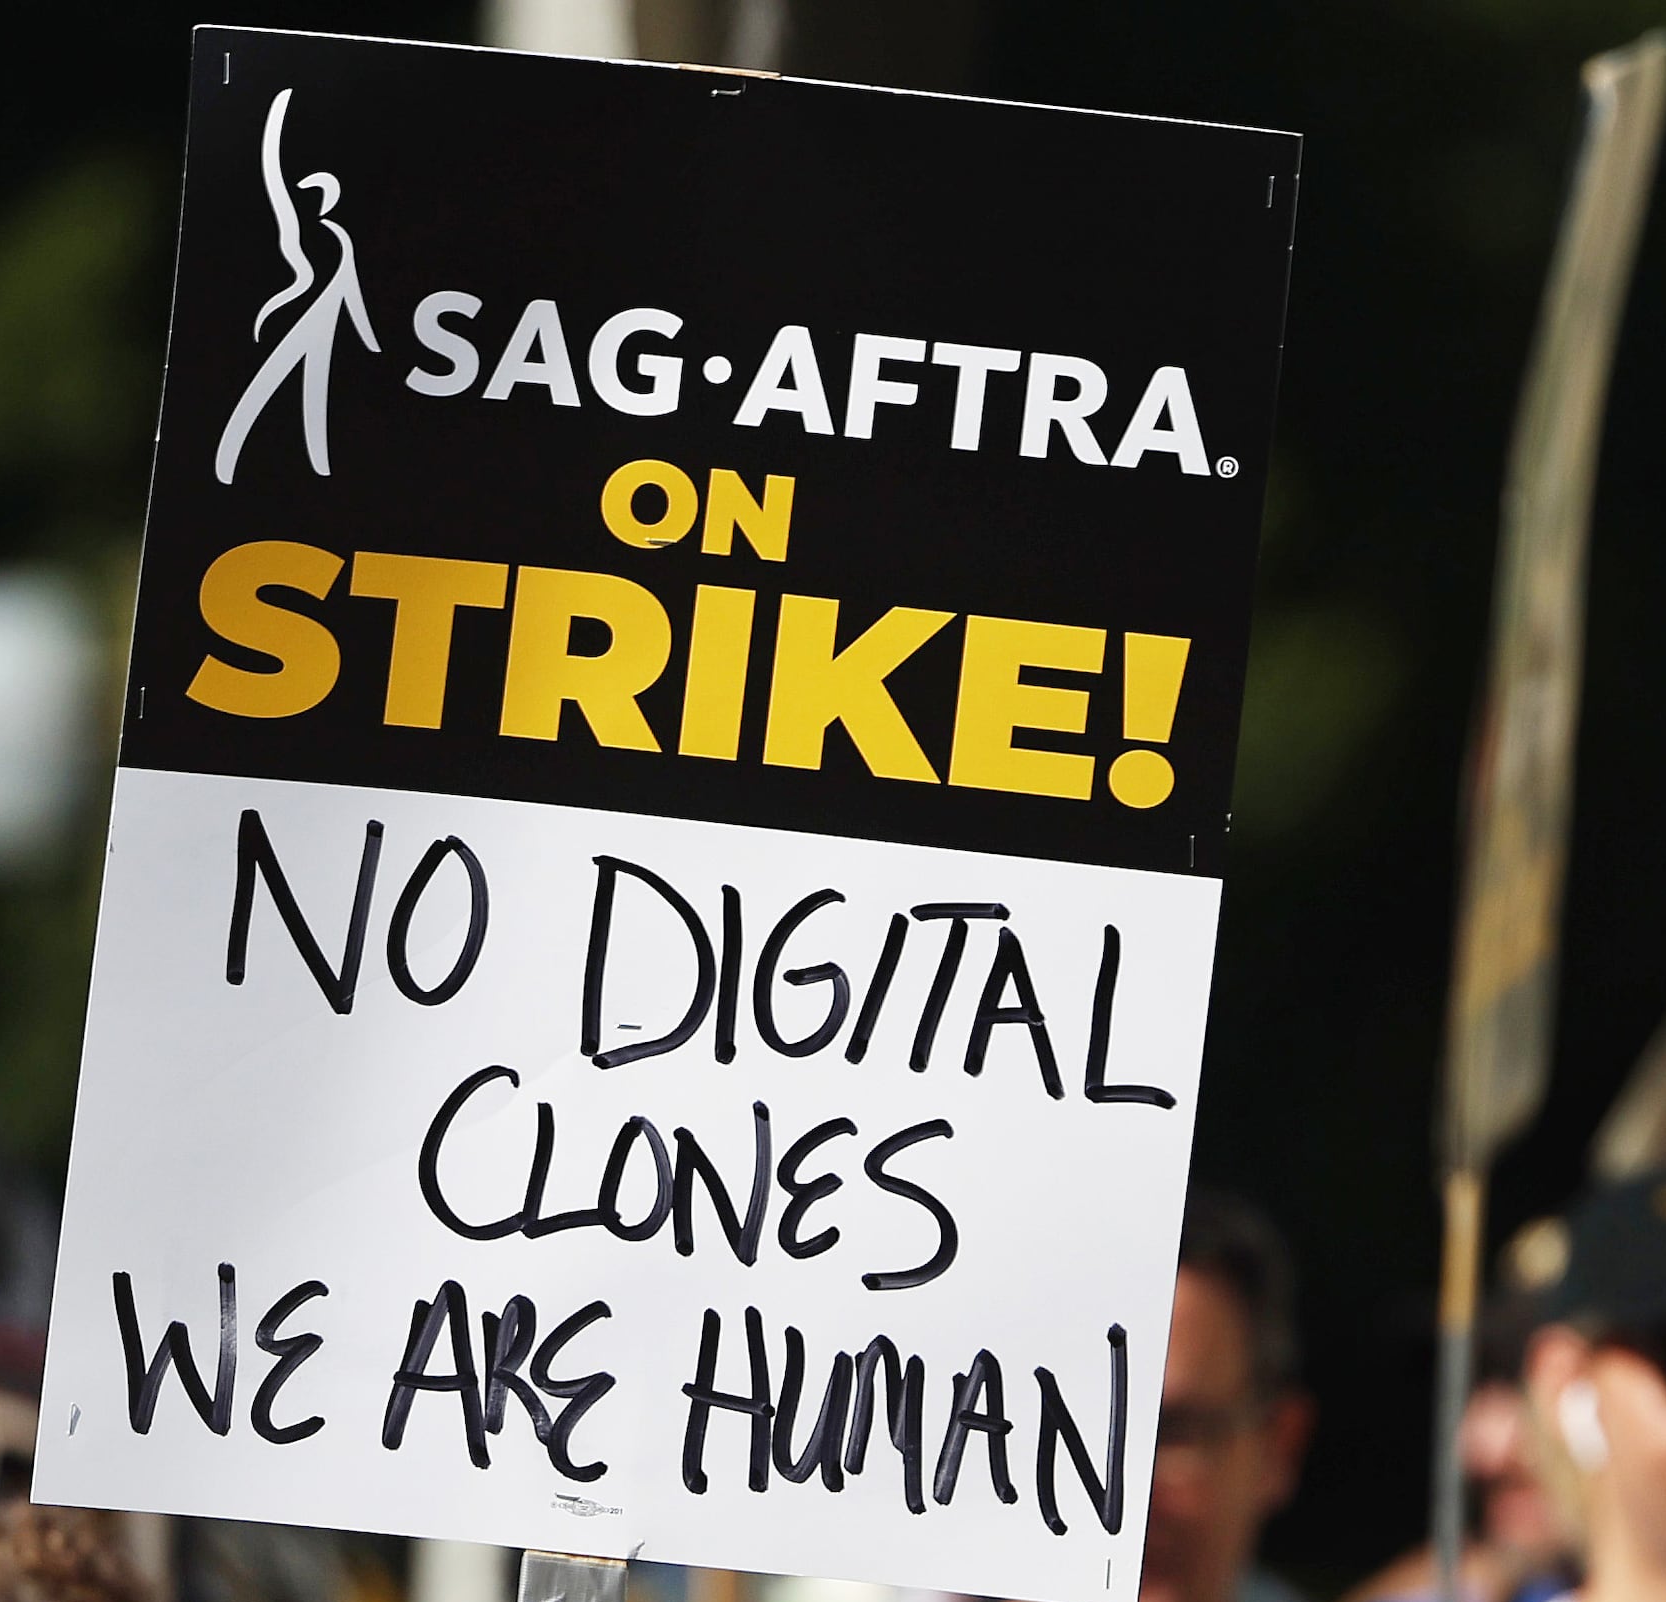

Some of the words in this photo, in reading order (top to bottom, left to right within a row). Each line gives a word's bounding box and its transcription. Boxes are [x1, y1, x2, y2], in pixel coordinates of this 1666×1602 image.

[601, 459, 795, 562] ON
[186, 541, 1191, 808] STRIKE!
[226, 809, 488, 1014] NO
[581, 855, 1176, 1109] DIGITAL
[419, 1065, 958, 1290] CLONES
[112, 1263, 329, 1444] WE
[382, 1280, 615, 1482] ARE
[682, 1306, 1127, 1535] HUMAN
